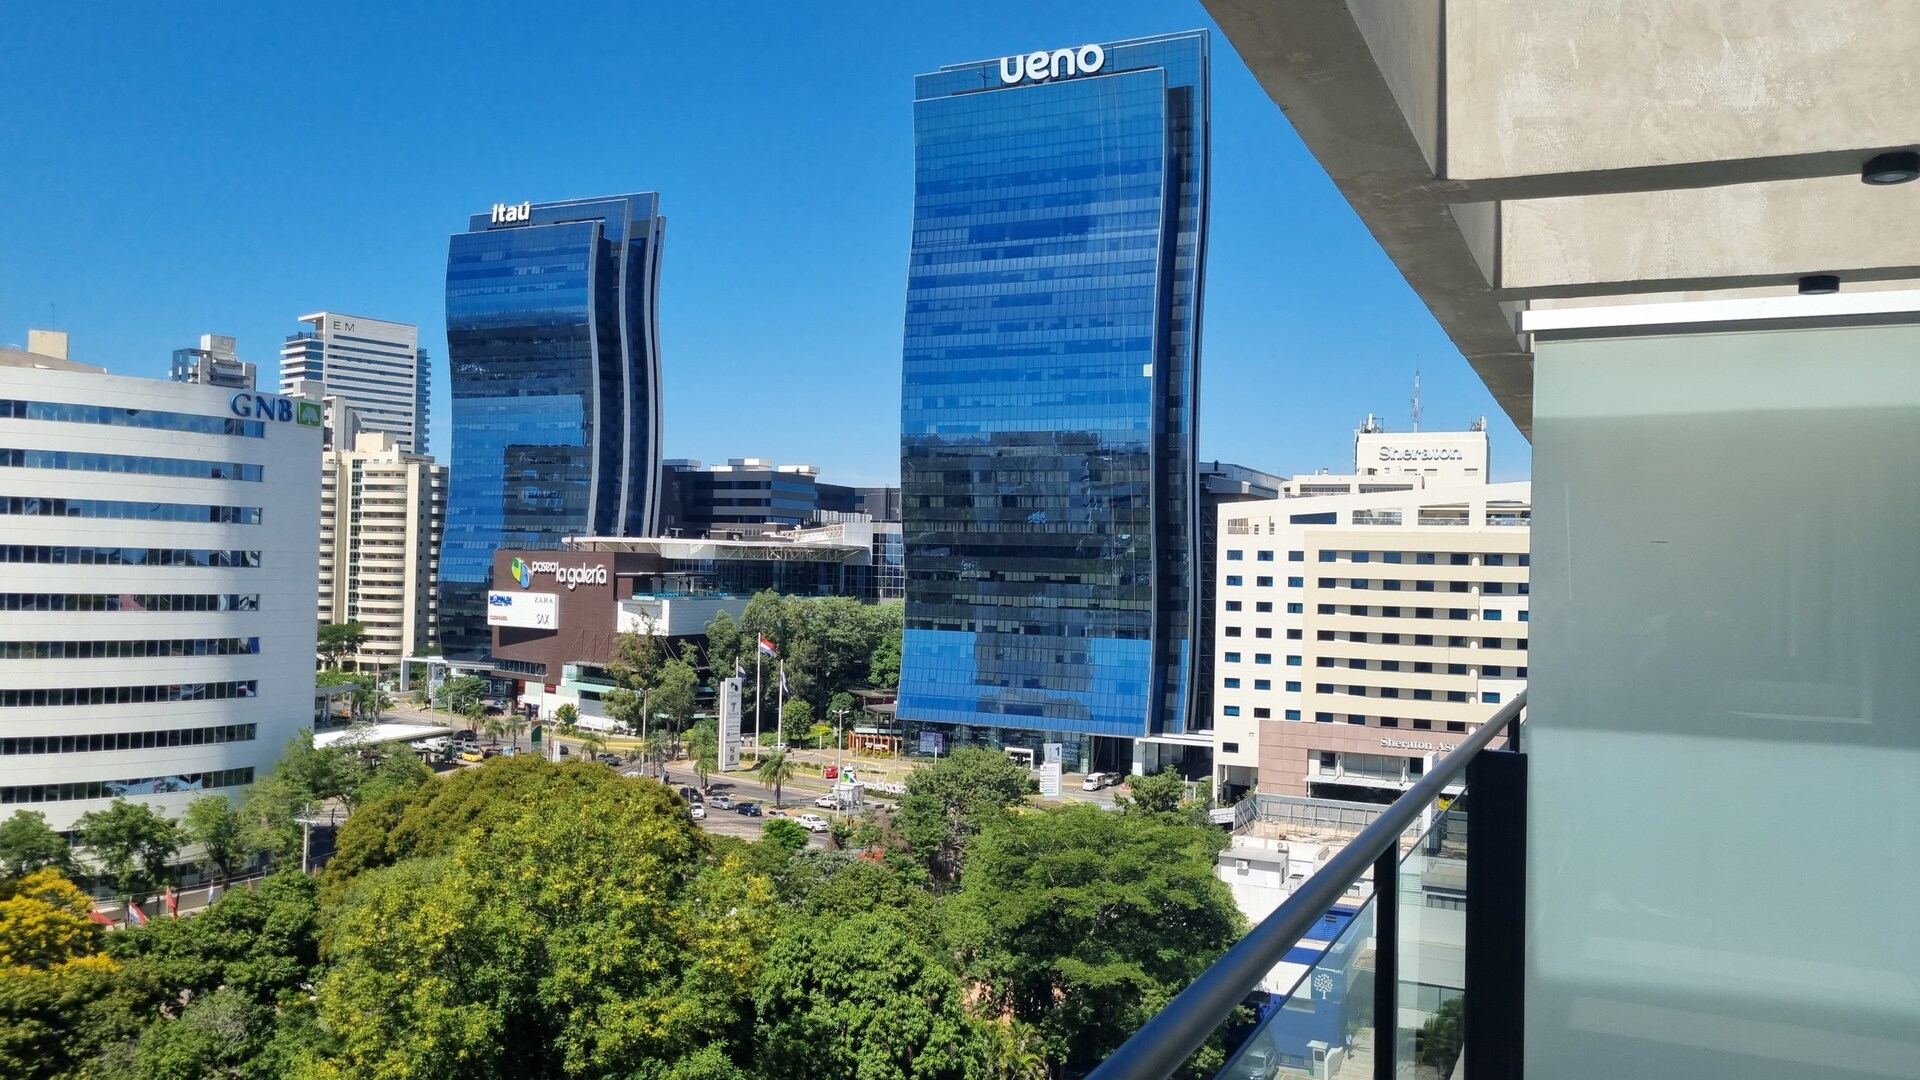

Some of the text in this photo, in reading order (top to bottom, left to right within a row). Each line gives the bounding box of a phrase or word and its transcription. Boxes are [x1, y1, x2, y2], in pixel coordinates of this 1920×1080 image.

[1000, 44, 1105, 84] ueno
[491, 201, 530, 223] Itaú
[230, 393, 293, 423] GNB
[1379, 446, 1463, 461] Sheraton
[531, 561, 607, 590] paseo la galería
[1380, 737, 1433, 751] Sheraton
